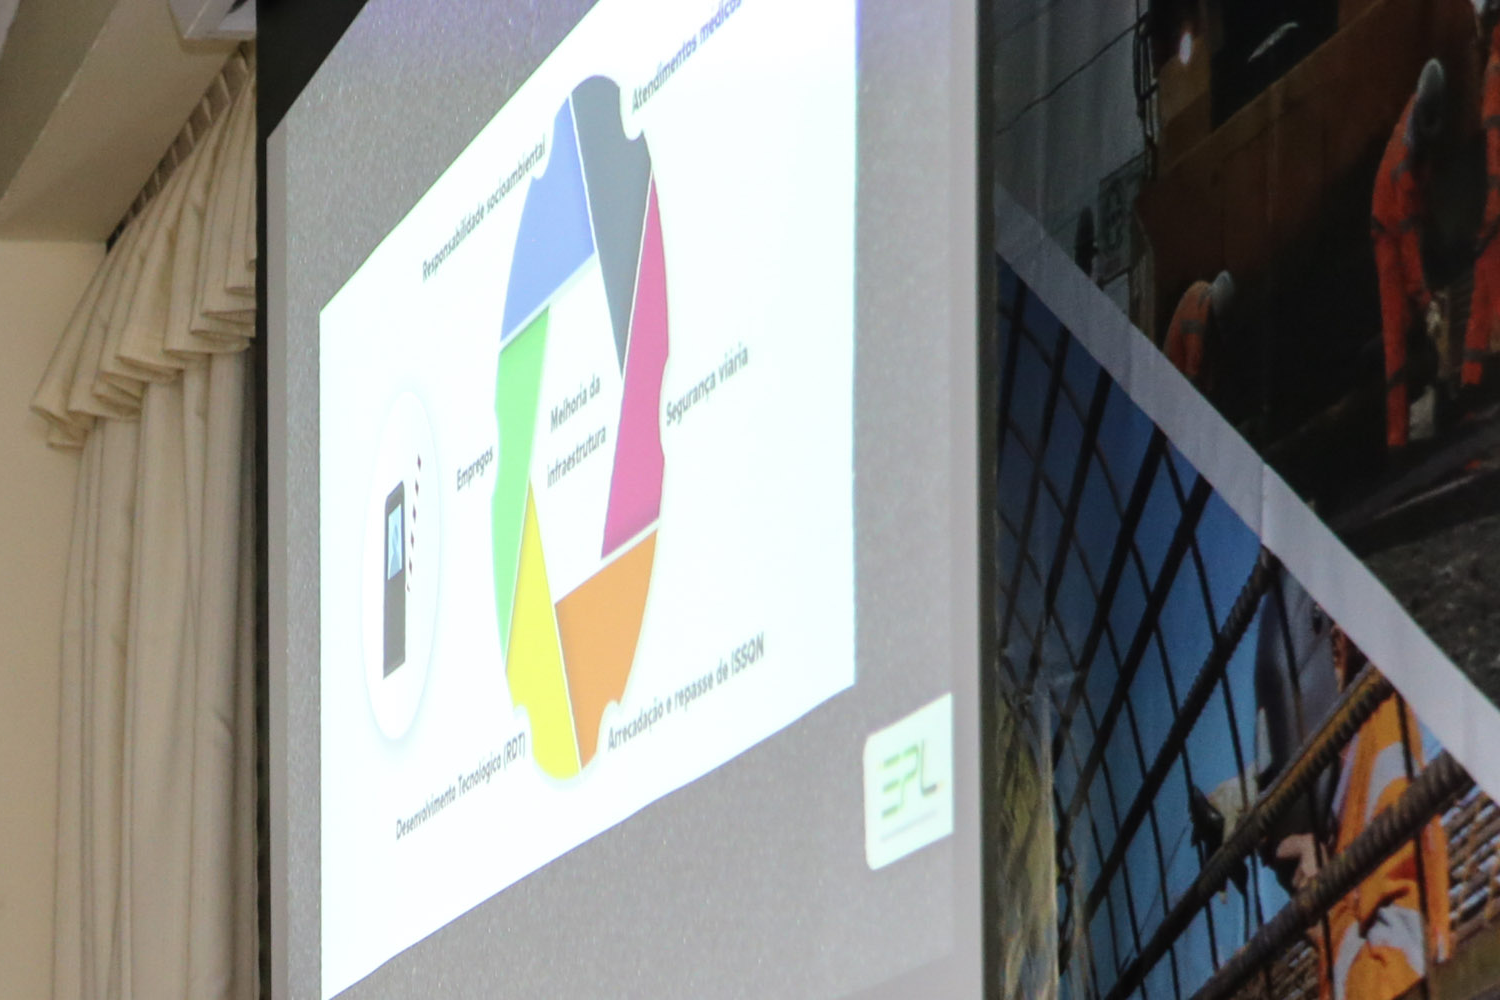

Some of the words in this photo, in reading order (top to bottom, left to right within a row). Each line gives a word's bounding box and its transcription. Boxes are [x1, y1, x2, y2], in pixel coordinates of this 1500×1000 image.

[632, 34, 697, 114] Atendimentos
[423, 202, 484, 282] Responsabilidade
[487, 133, 545, 213] socioambiental
[551, 382, 587, 432] Melhoria
[590, 374, 601, 400] da
[667, 371, 716, 427] Segurança
[457, 446, 493, 492] Empregos
[547, 425, 606, 489] infraestrutura
[608, 697, 664, 752] Arrecadação
[666, 697, 672, 715] e
[675, 672, 714, 712] repasse
[716, 658, 729, 686] de
[396, 785, 456, 841] Desenvolvimento
[503, 731, 525, 771] (RDT)
